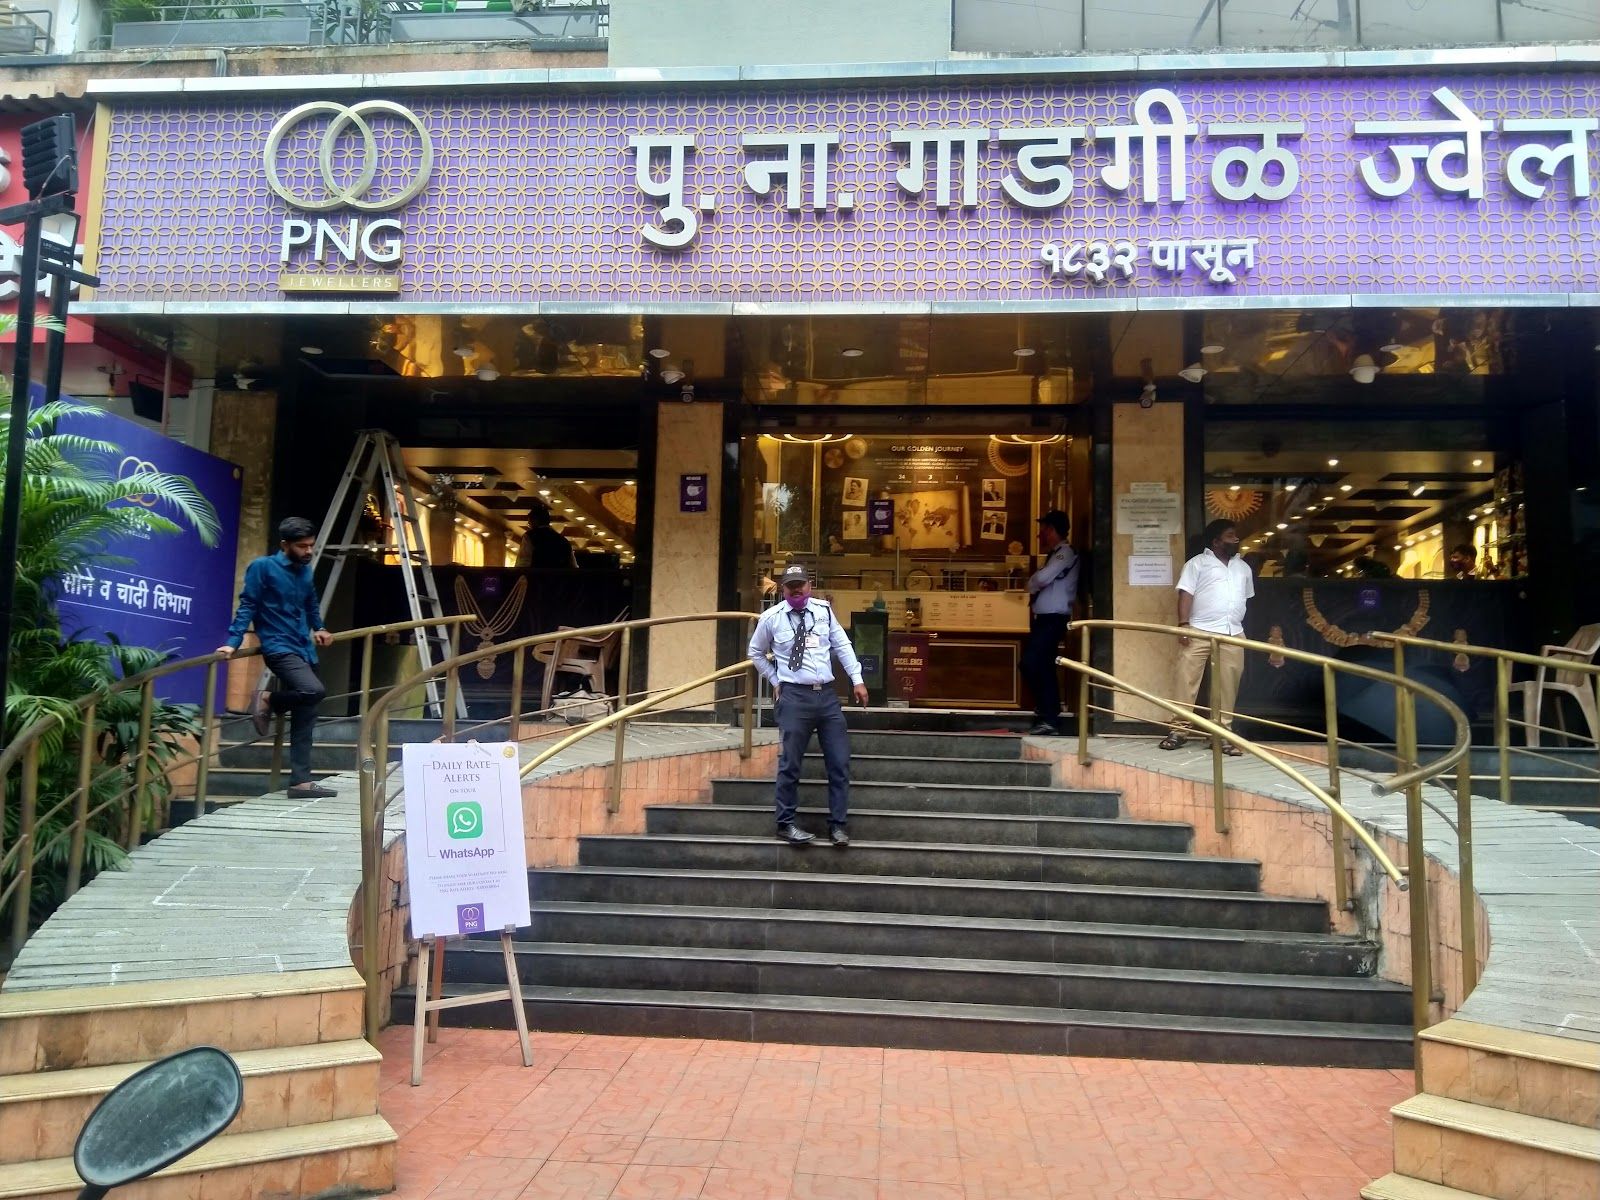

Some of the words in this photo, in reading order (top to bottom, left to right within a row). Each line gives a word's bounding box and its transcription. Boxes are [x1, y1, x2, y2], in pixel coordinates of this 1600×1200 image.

[891, 88, 1303, 211] गाडगीळ
[280, 218, 402, 263] PNG
[1040, 242, 1138, 283] १८३२
[1148, 238, 1259, 283] पासून
[289, 277, 393, 289] JEWELLERS
[934, 445, 965, 453] JOURNEY
[100, 578, 112, 601] व
[116, 578, 149, 609] चांदी
[153, 584, 192, 615] विभाग
[432, 760, 463, 770] DAILY
[466, 760, 491, 769] RATE
[443, 773, 481, 783] ALERTS
[439, 847, 495, 859] WhatsApp
